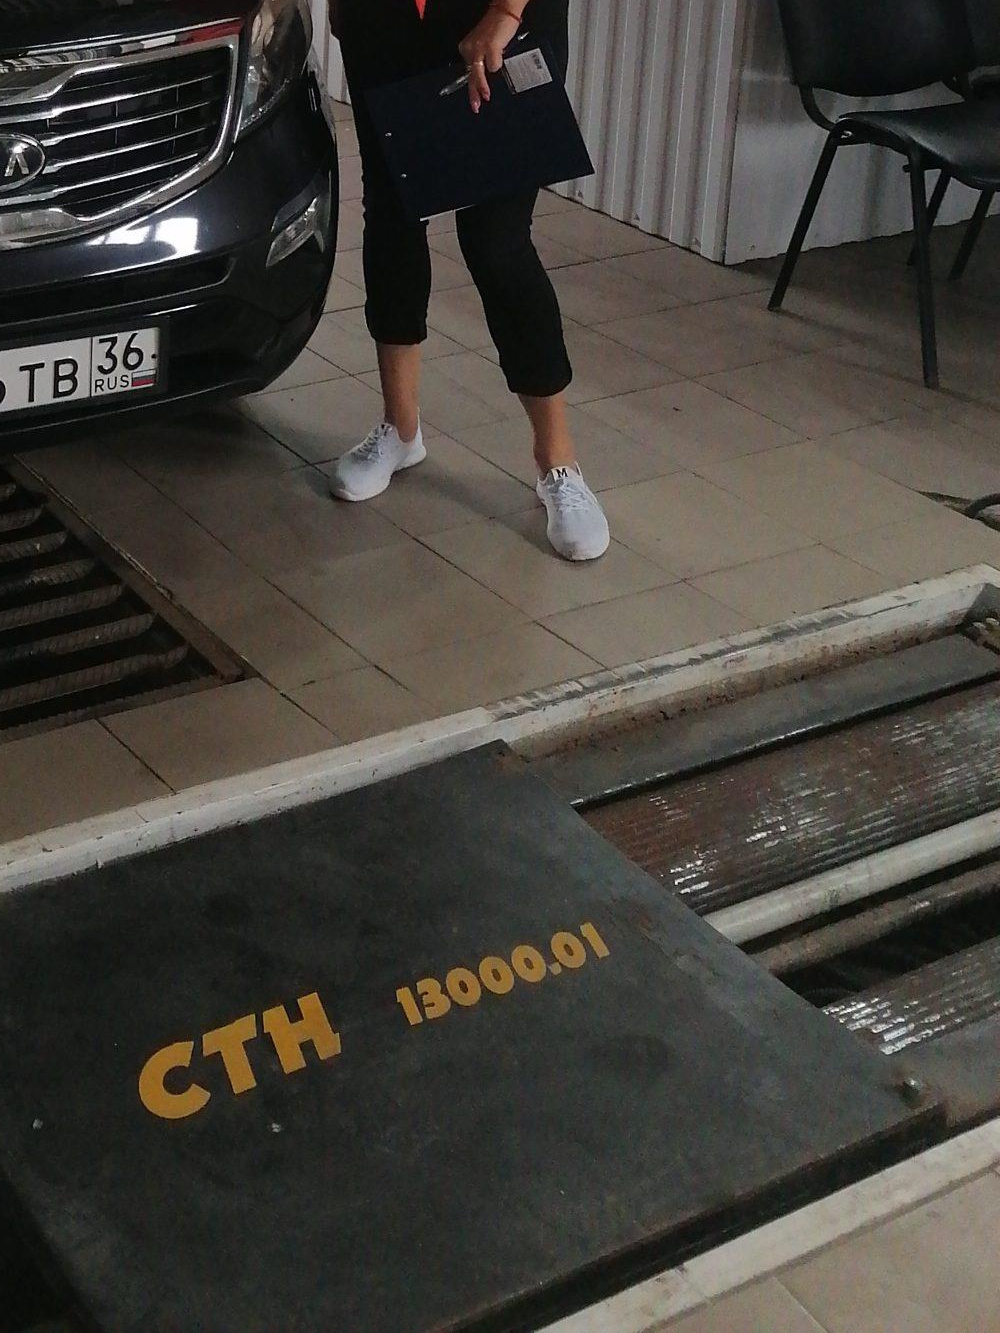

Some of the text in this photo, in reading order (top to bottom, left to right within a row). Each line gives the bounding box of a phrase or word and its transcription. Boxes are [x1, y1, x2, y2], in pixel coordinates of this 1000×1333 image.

[97, 333, 144, 375] 36
[94, 374, 130, 392] RUS
[396, 922, 610, 1026] 13000.01
